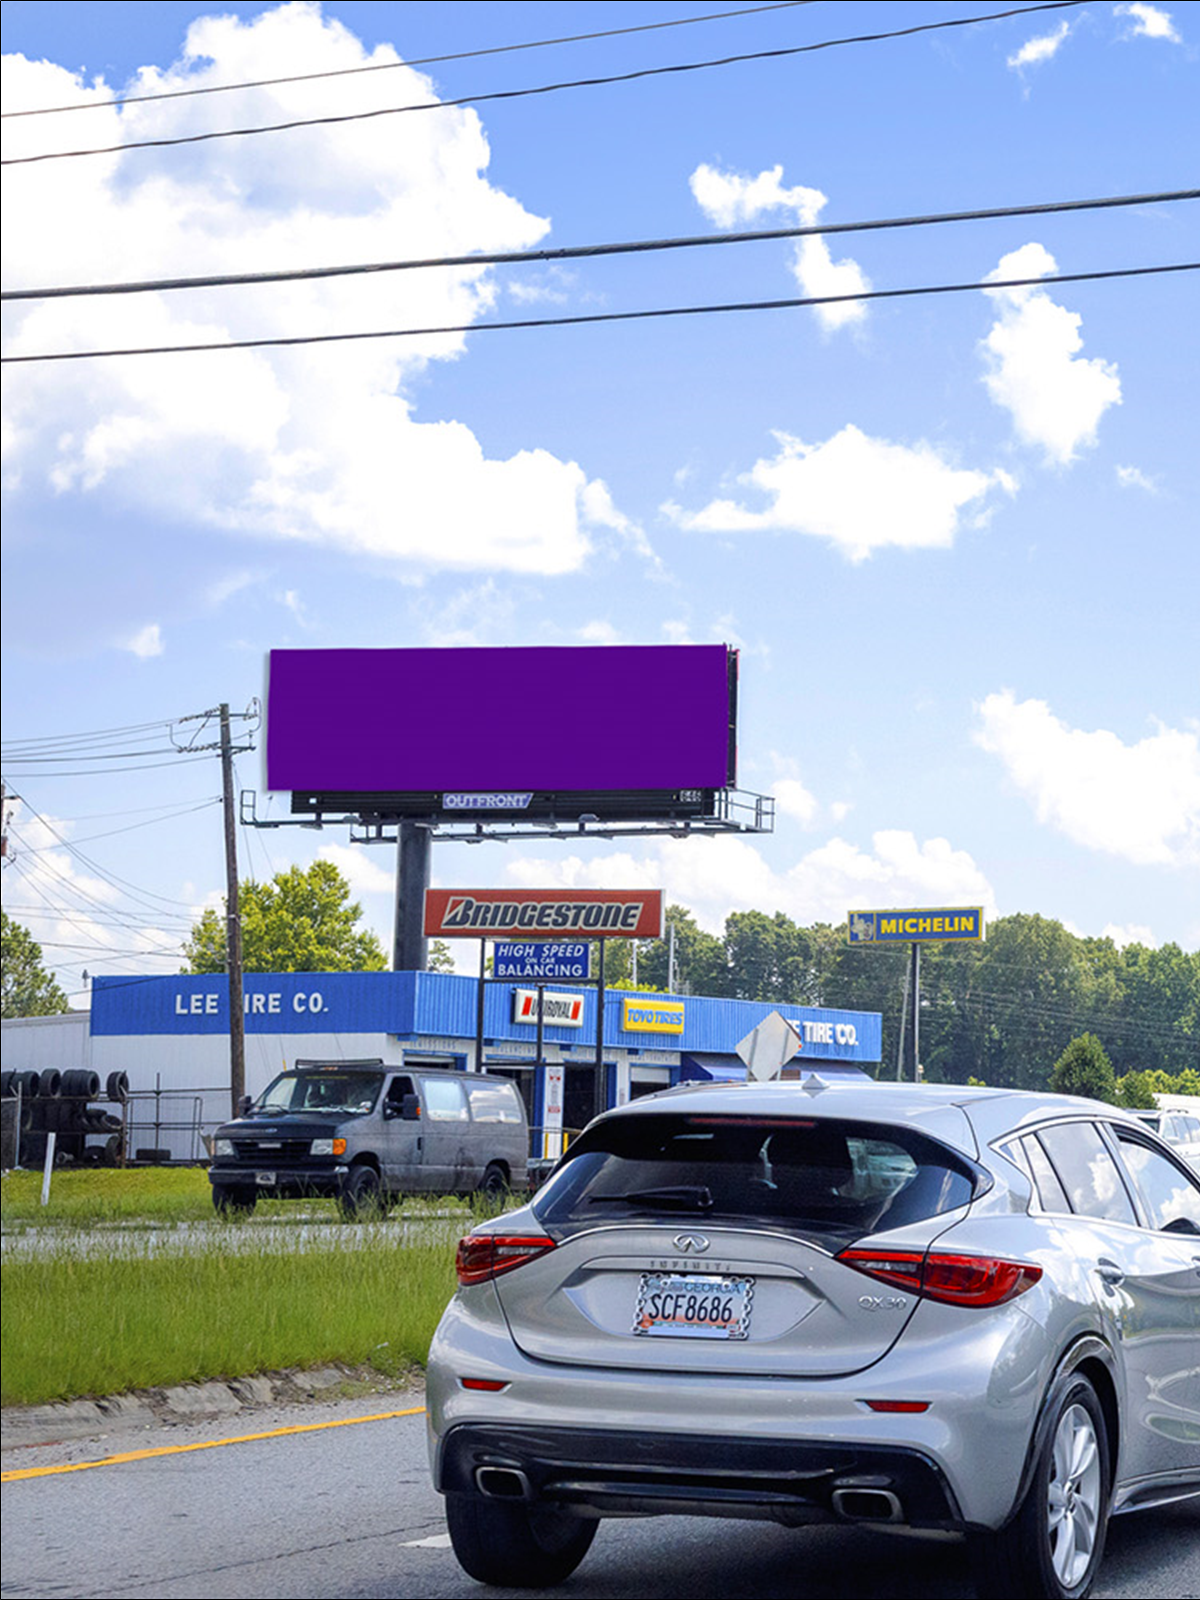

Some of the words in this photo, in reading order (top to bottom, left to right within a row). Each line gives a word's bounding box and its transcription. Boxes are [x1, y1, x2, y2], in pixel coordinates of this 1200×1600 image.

[446, 795, 527, 807] OUTFRONT
[441, 896, 643, 930] BRIDGESTONE
[880, 917, 975, 934] MICHELIN
[498, 945, 535, 957] HIGH
[542, 945, 584, 957] SPEED
[498, 964, 583, 977] BALANCING
[175, 994, 219, 1014] LEE
[243, 993, 281, 1013] IRE
[293, 992, 329, 1013] CO.
[531, 999, 571, 1018] UIROYAL
[628, 1009, 653, 1023] TOYO
[655, 1010, 683, 1026] TIRES
[802, 1021, 833, 1044] TIRE
[835, 1023, 859, 1045] CO.
[648, 1293, 733, 1323] SCF8686
[859, 1295, 907, 1312] QX30
